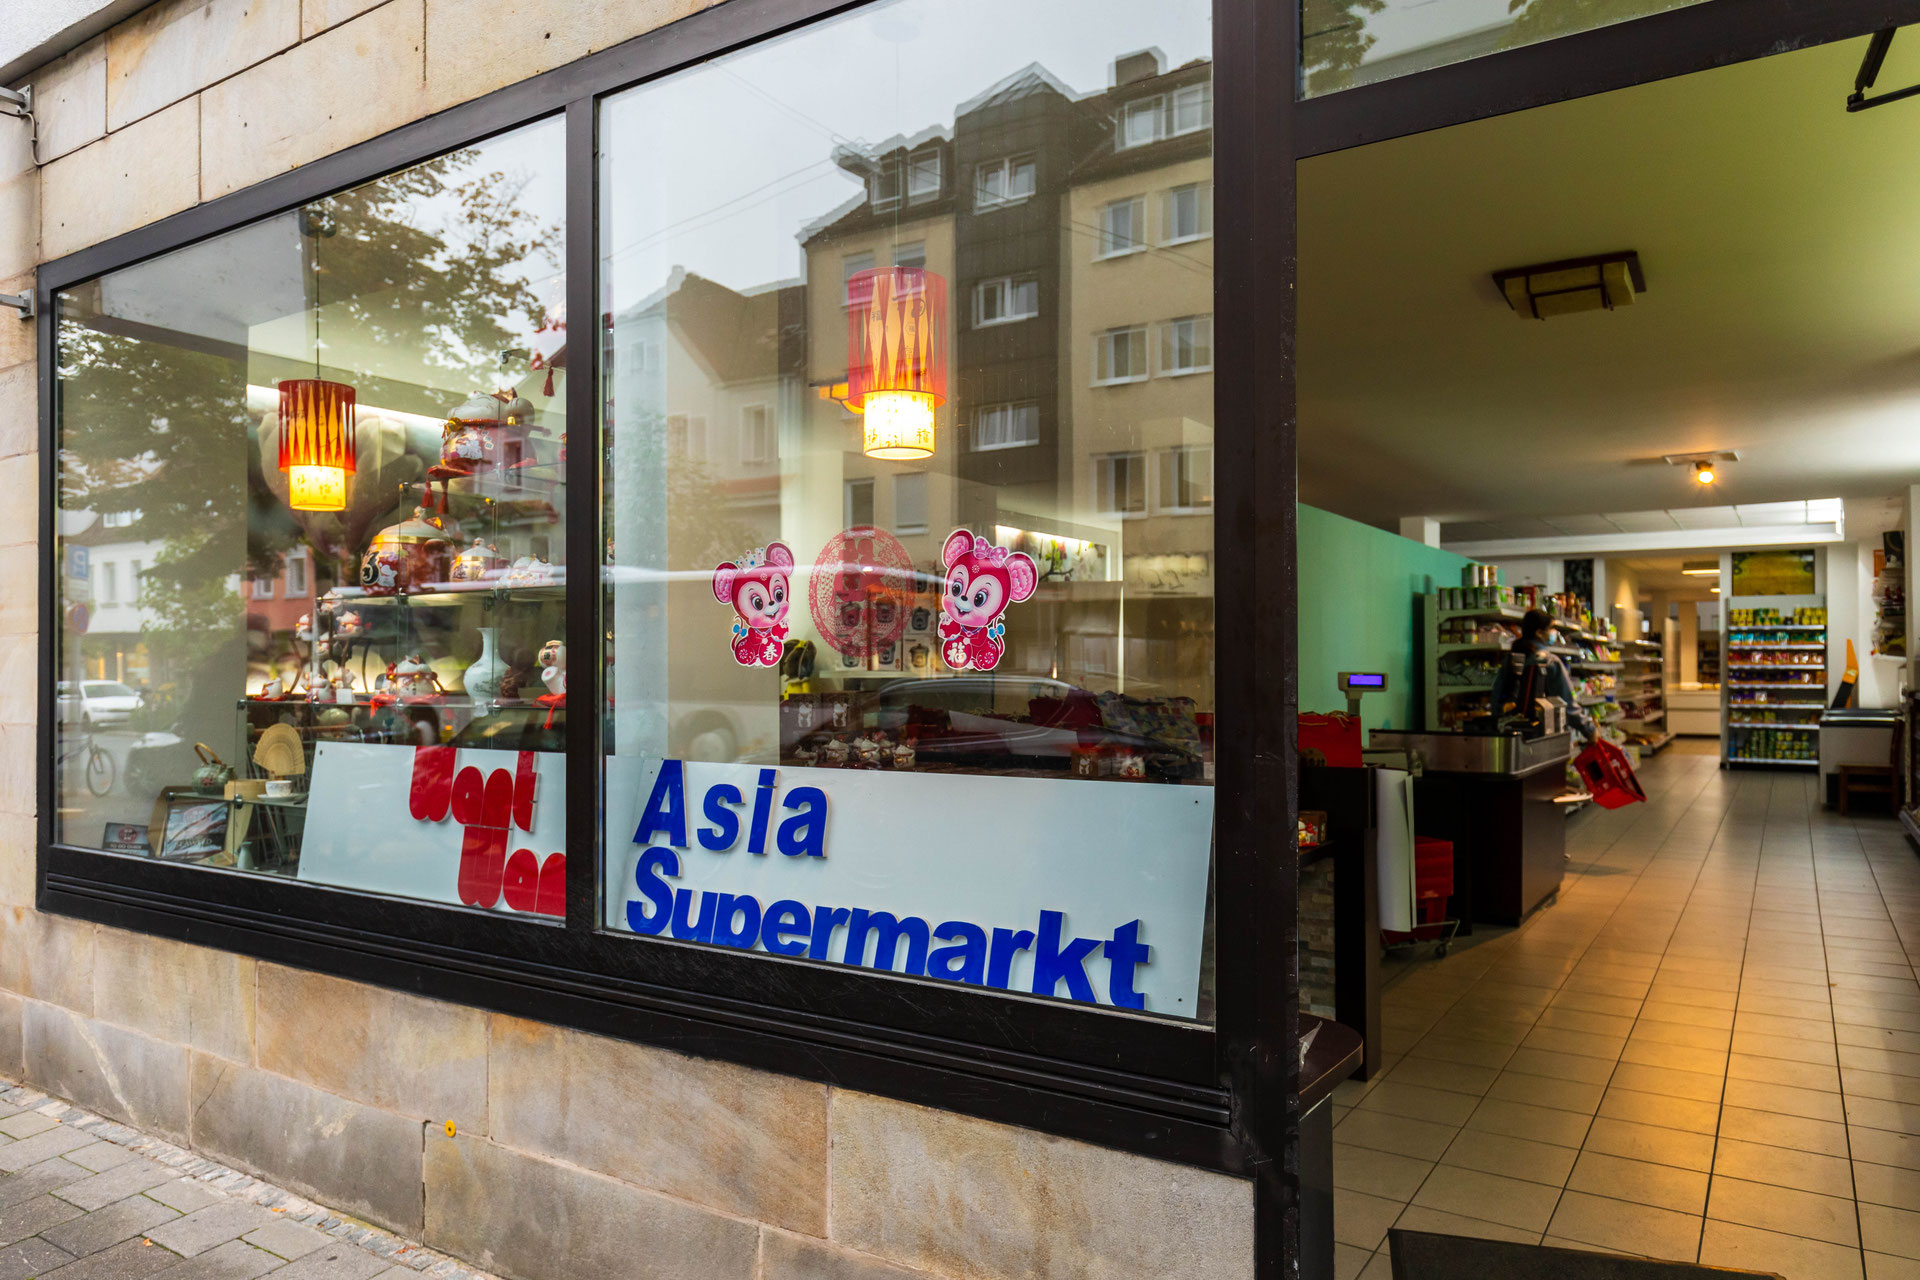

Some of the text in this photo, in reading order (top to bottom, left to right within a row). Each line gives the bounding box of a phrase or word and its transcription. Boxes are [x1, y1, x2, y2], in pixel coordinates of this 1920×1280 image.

[762, 641, 779, 661] 春
[947, 641, 967, 663] 福
[632, 759, 829, 859] Asia
[626, 846, 1150, 1011] Supermarkt
